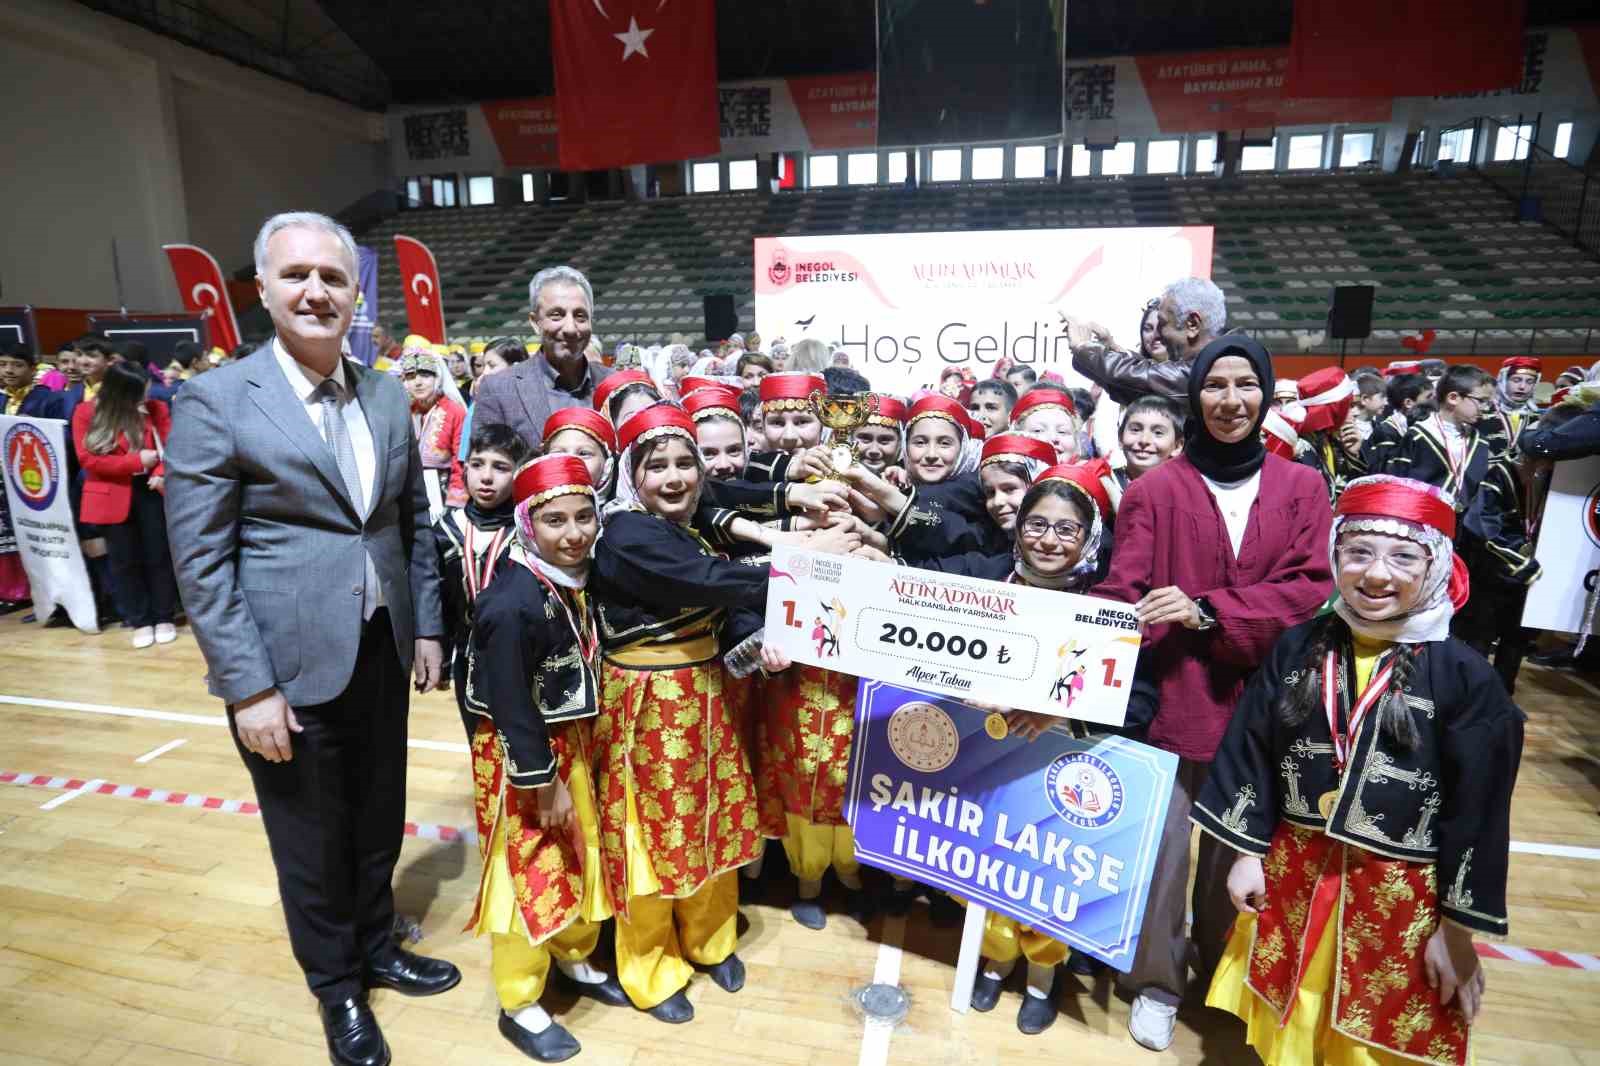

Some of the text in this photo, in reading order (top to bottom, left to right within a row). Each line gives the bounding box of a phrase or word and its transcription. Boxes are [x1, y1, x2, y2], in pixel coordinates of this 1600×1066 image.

[841, 322, 922, 375] Hoş
[782, 600, 803, 628] 1.
[889, 578, 1018, 616] ALTIN ADIMLAR
[898, 596, 921, 606] HALK
[921, 600, 962, 615] DANSLARI
[879, 622, 988, 661] 20.000
[905, 665, 938, 683] Alper
[939, 670, 972, 689] Taban
[1100, 658, 1122, 688] 1.
[869, 774, 1126, 895] ŞAKİR LAKŞE
[892, 816, 1082, 924] İLKOKULU
